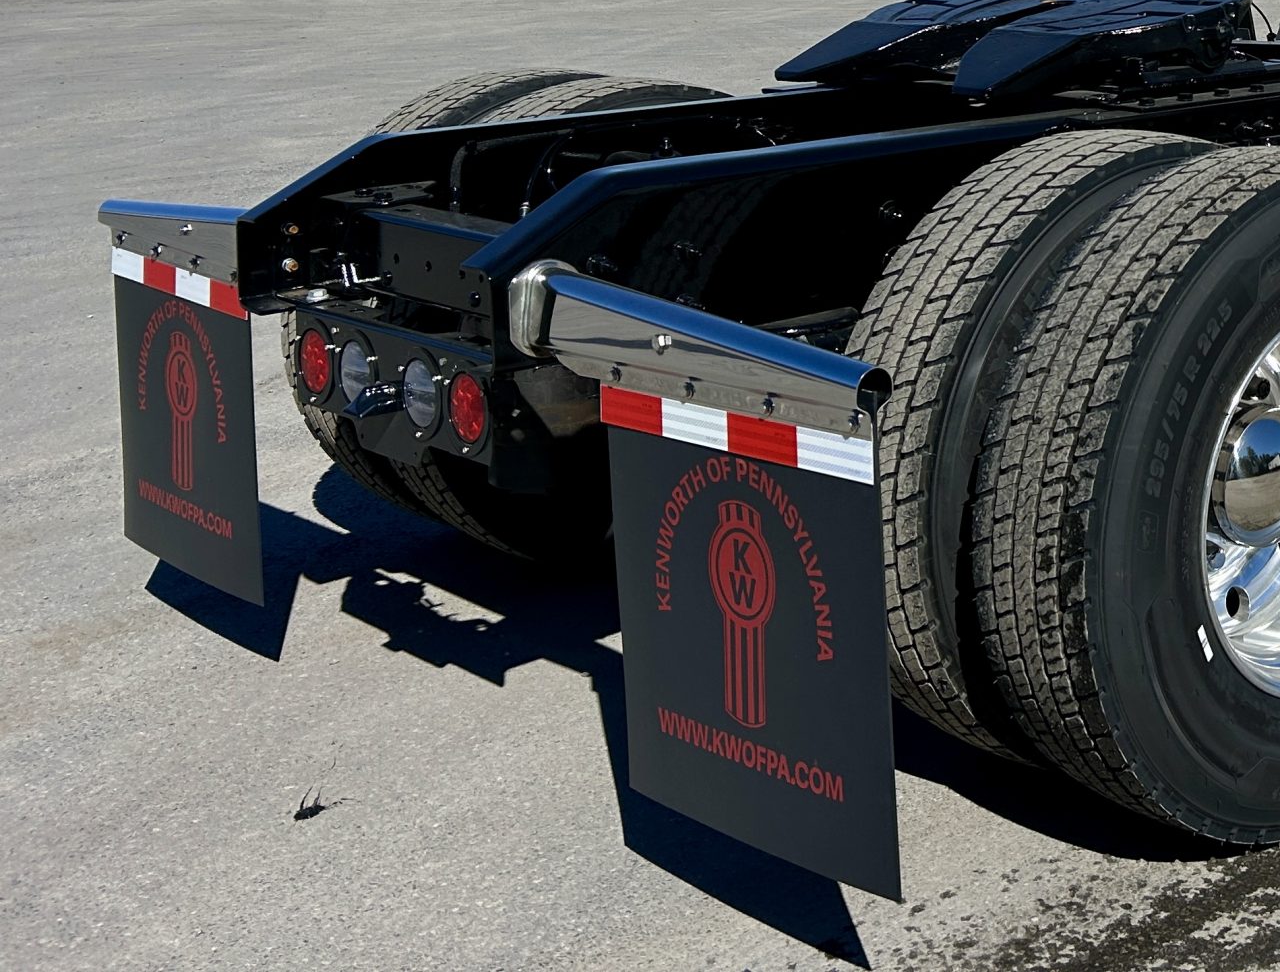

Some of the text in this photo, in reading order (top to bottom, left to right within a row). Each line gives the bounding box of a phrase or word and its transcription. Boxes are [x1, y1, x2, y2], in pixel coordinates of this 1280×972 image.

[138, 300, 227, 443] KENWORTH OF PENNSYLVANIA
[1183, 354, 1202, 384] R
[1197, 298, 1234, 358] 22.5
[138, 478, 233, 540] WWW.KWOFPA.COM
[655, 456, 834, 662] KENWORTH OF PENNSYLVANIA
[657, 706, 845, 803] WWW.KWOFPA.COM
